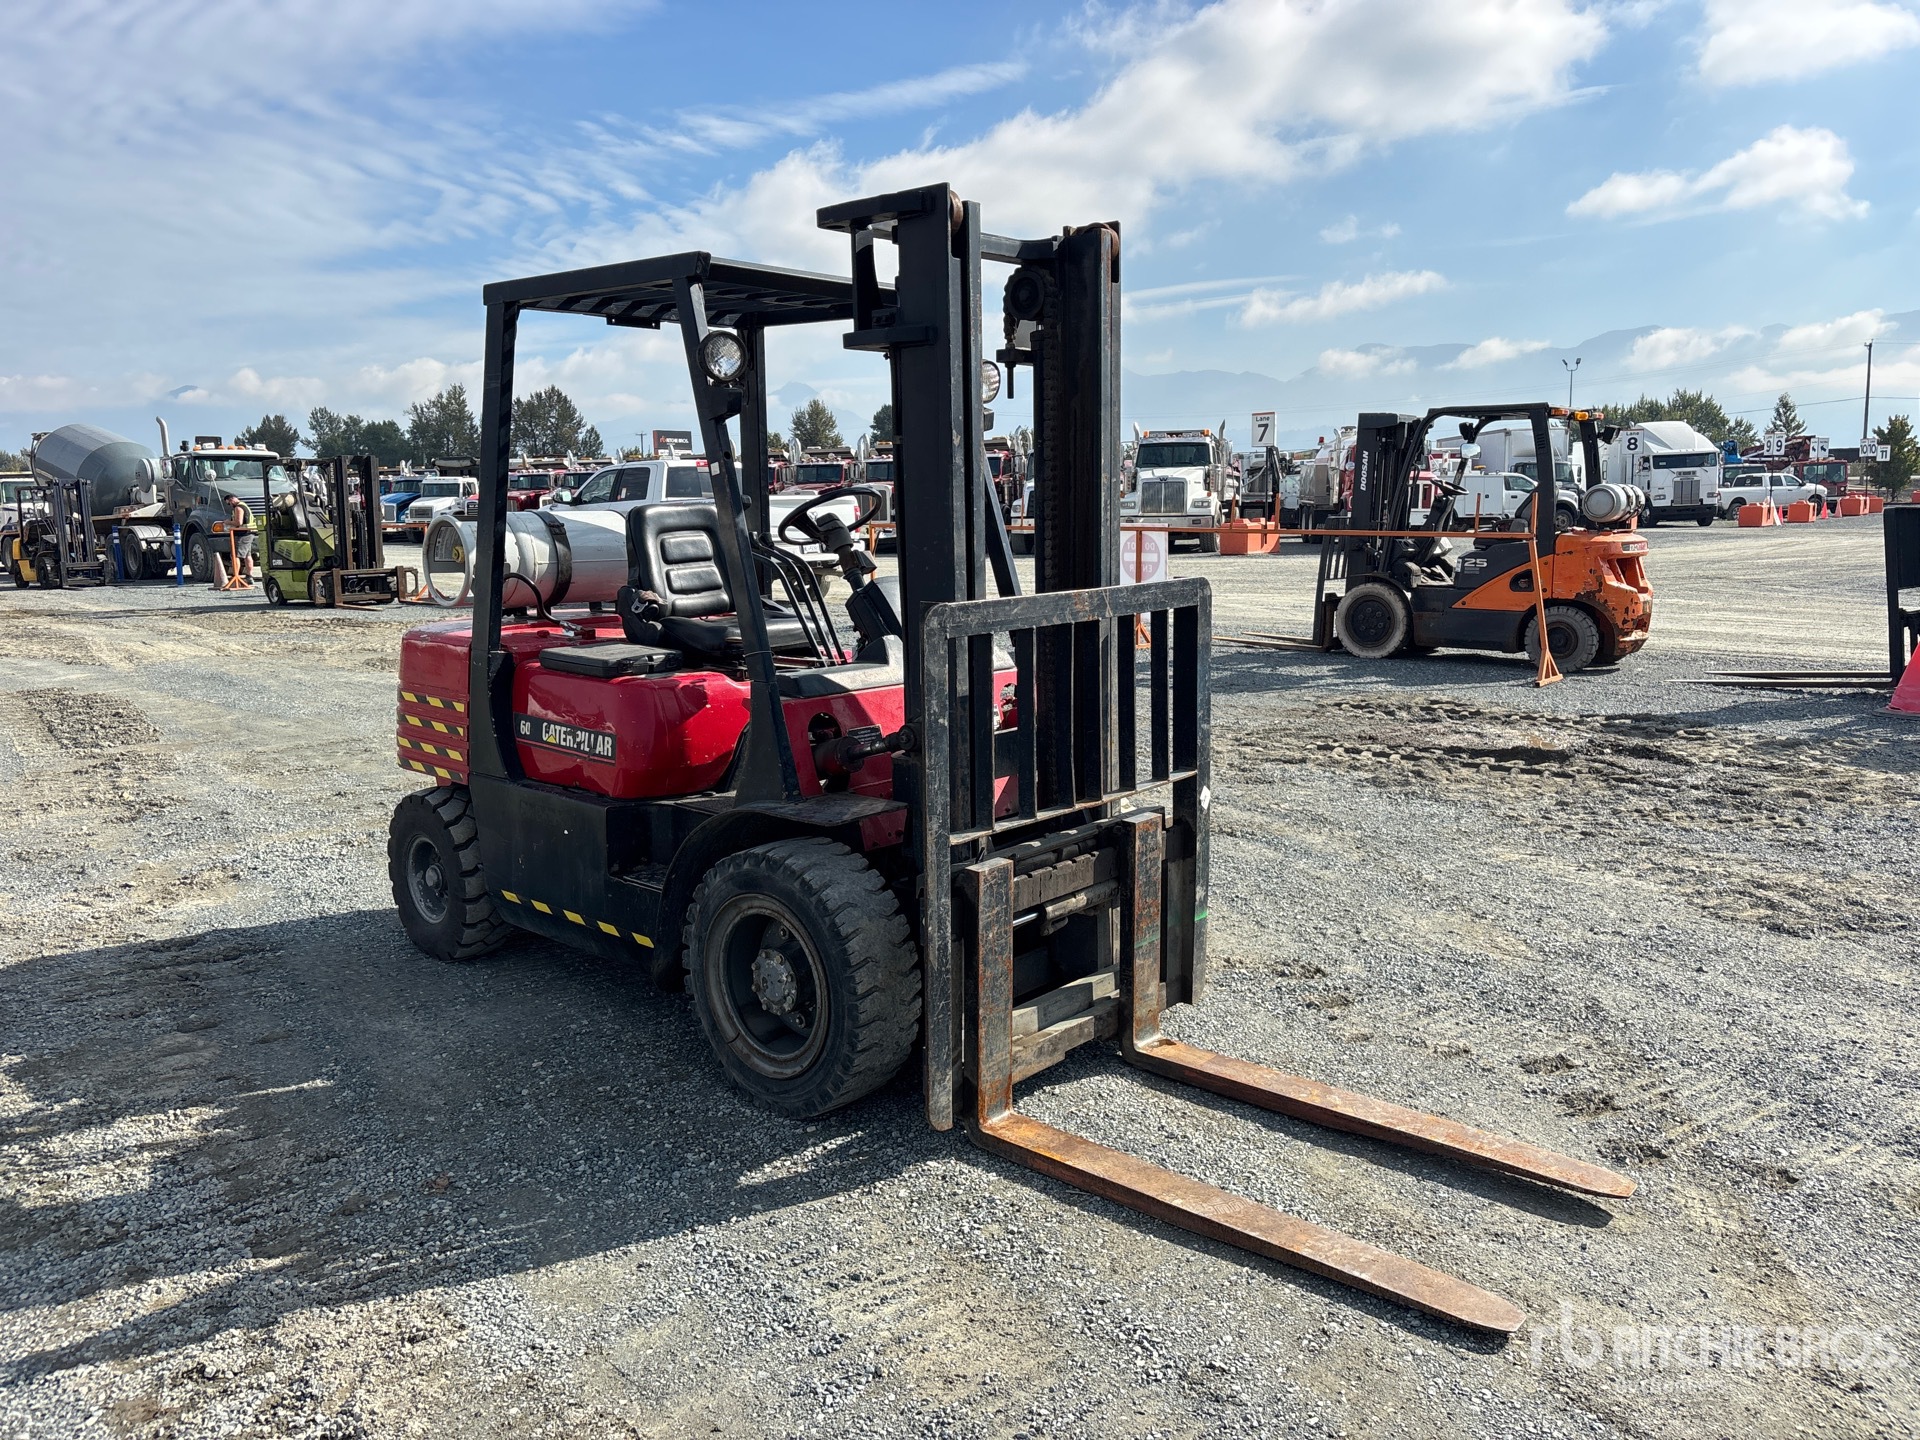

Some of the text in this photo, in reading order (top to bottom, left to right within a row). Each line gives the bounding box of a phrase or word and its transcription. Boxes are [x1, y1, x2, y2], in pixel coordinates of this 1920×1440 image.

[1257, 423, 1269, 442] 7
[1626, 437, 1638, 451] 8
[1766, 440, 1772, 453] 9
[1776, 440, 1783, 452] 9
[1860, 444, 1867, 455] 10
[1868, 443, 1876, 454] 10
[1880, 450, 1888, 459] 11
[1360, 450, 1369, 491] DOOSAN
[1464, 558, 1488, 568] 25
[520, 720, 613, 757] 60 CATERPILLAR
